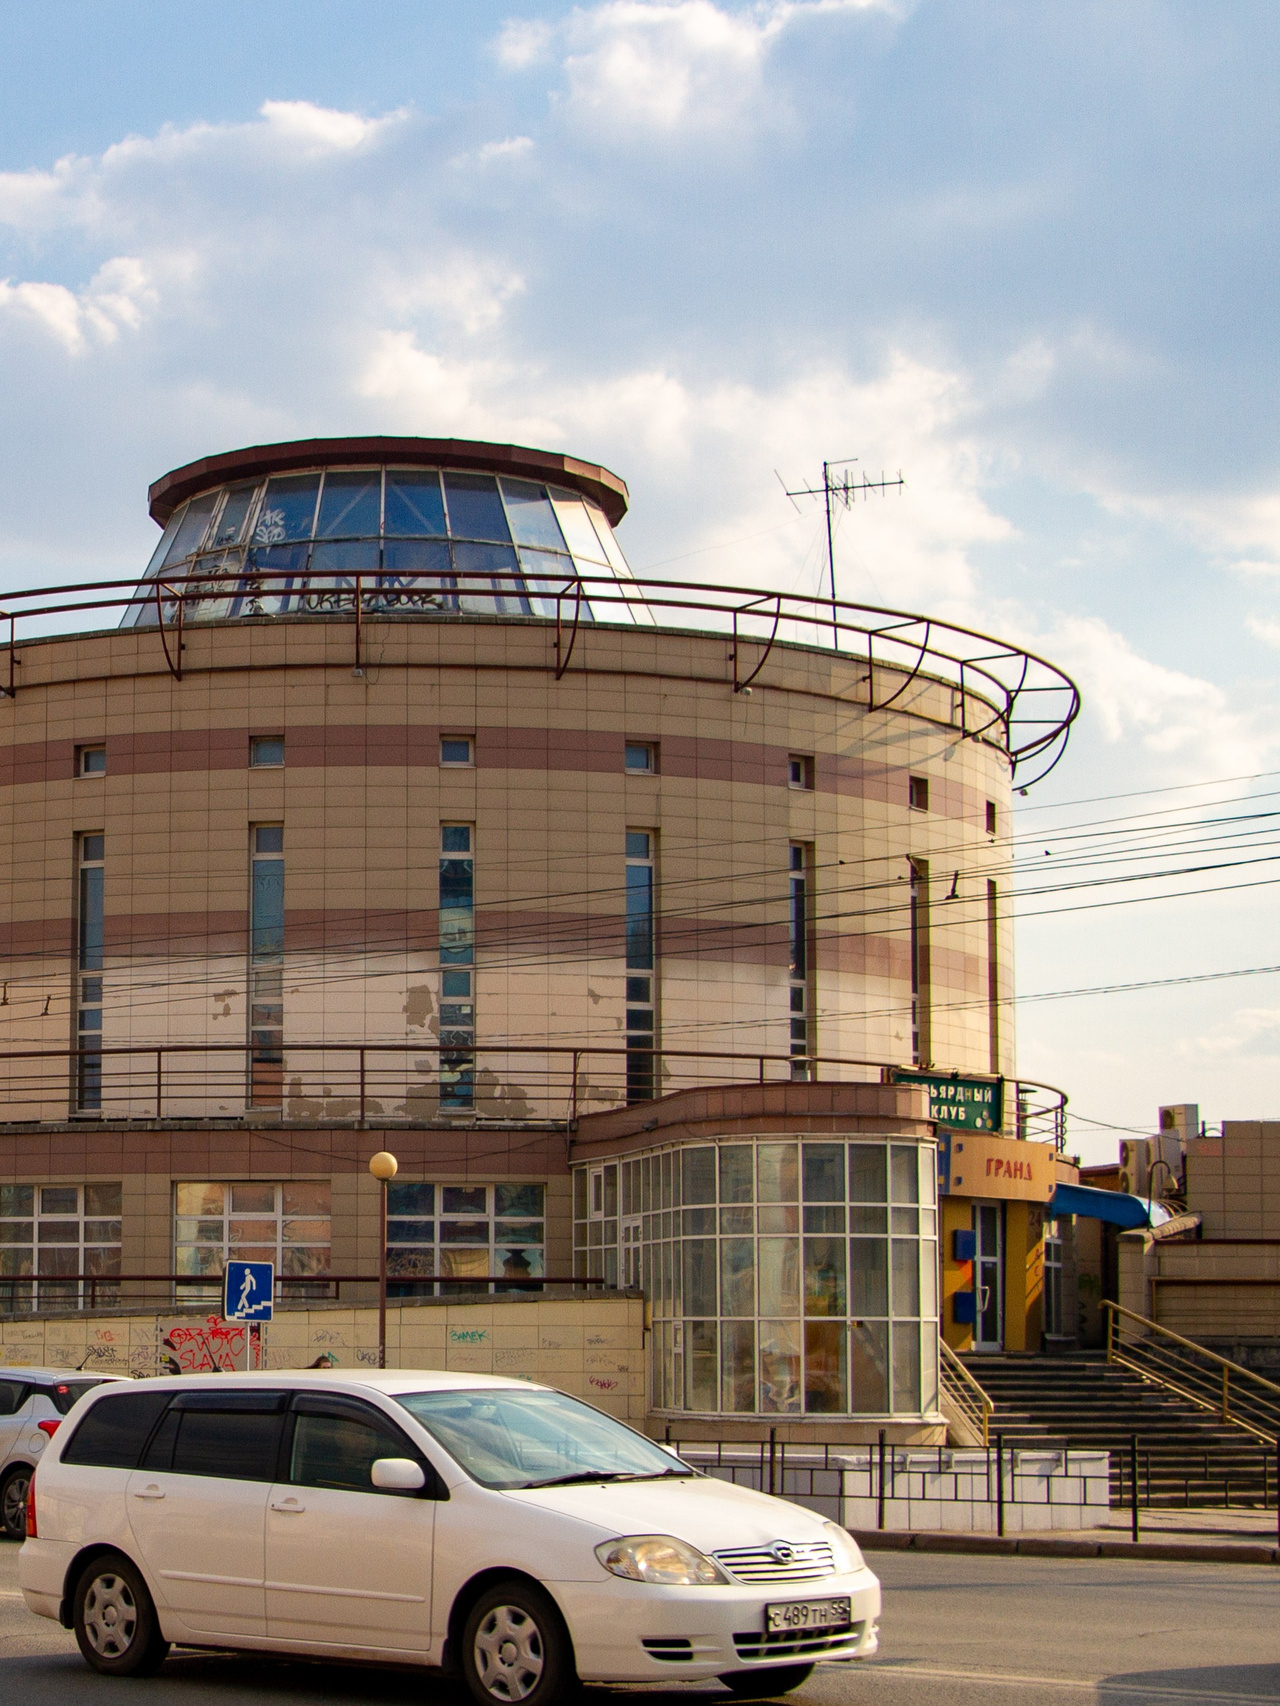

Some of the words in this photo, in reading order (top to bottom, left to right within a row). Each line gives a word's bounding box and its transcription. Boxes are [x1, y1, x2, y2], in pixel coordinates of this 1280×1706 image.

[930, 1105, 966, 1120] КЛУБ
[986, 1158, 1033, 1182] ГРАНД
[831, 1600, 846, 1616] 55
